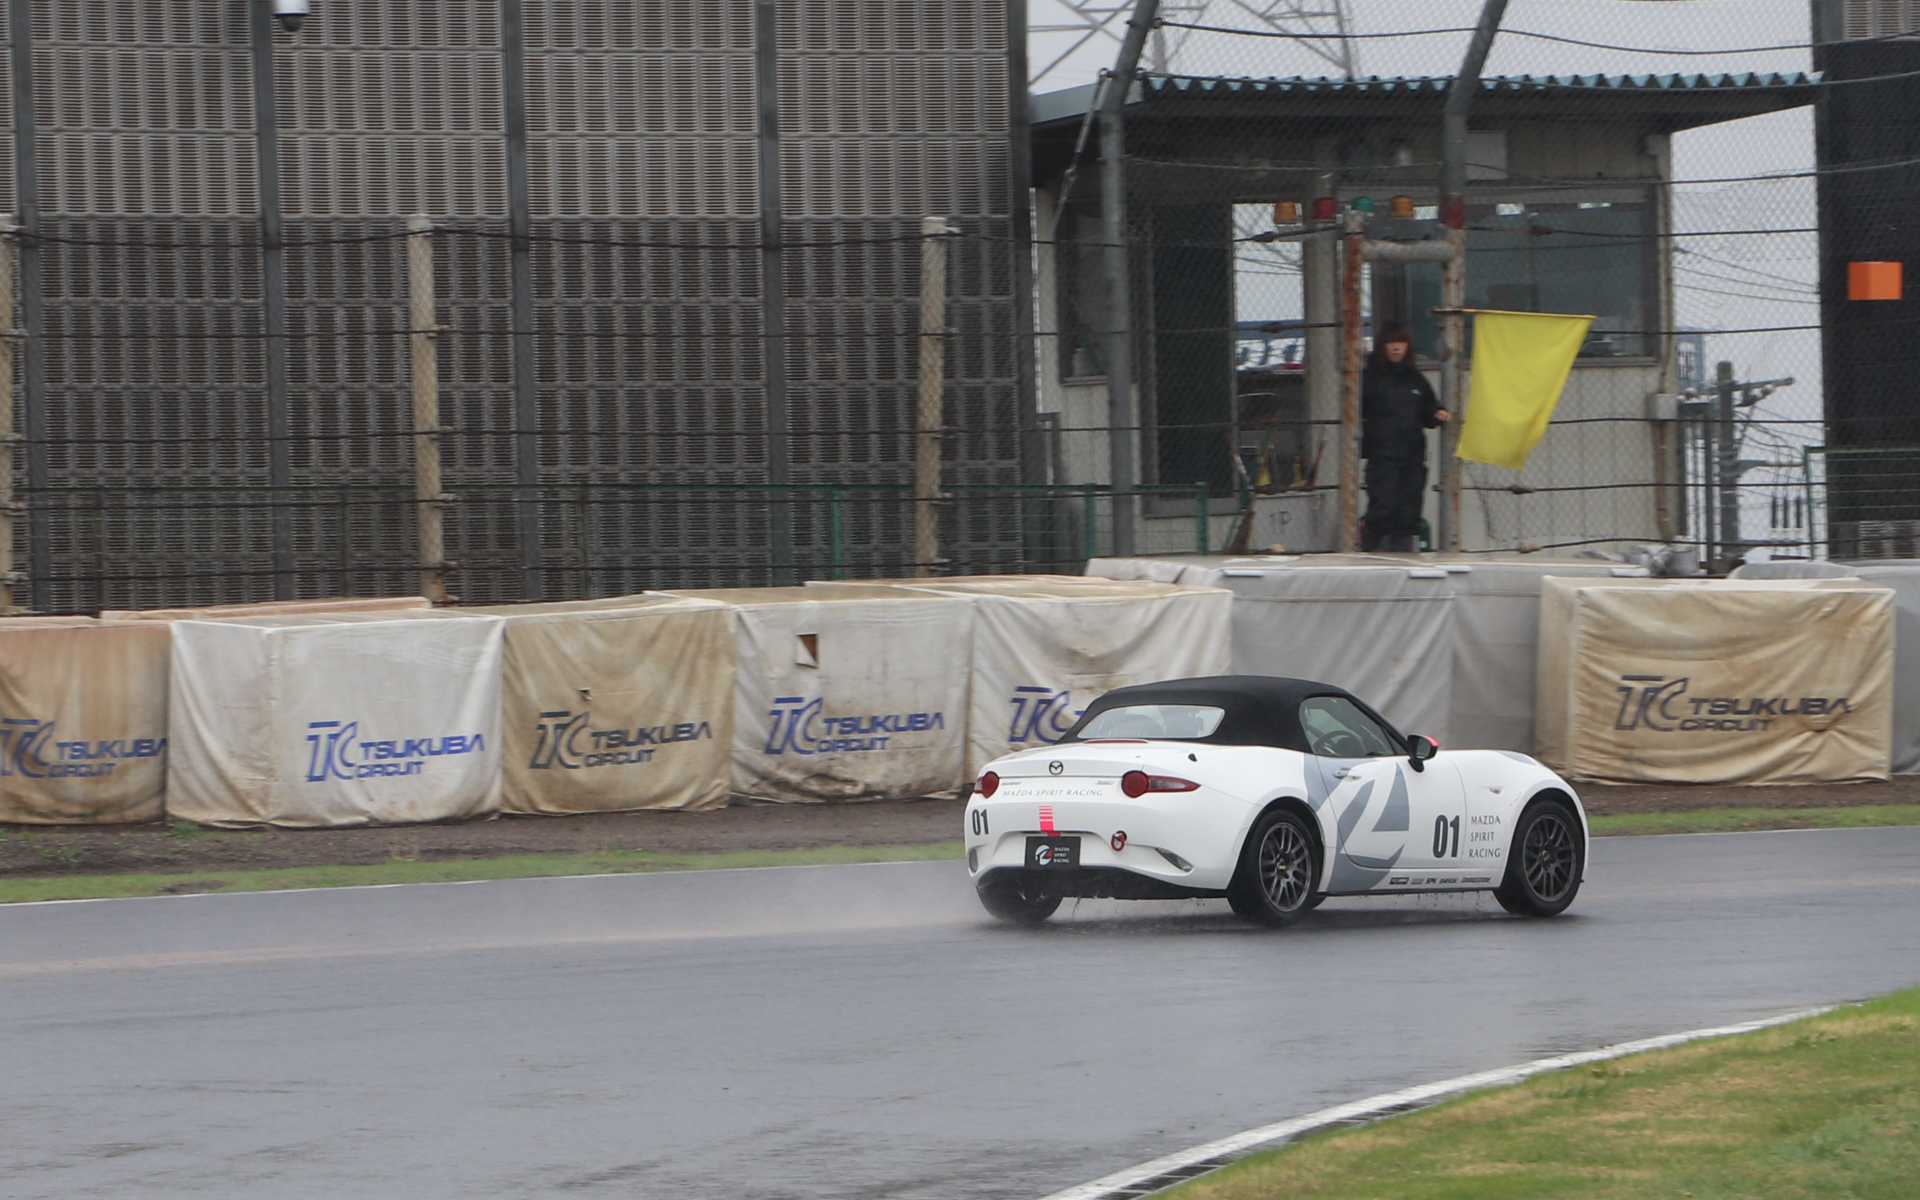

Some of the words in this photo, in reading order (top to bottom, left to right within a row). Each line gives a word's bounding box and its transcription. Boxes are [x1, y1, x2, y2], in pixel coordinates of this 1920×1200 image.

[1690, 698, 1853, 716] TSUKUBA
[823, 712, 945, 736] TSUKUBA
[1679, 718, 1773, 732] CIRCUIT
[591, 721, 713, 750] TSUKUBA
[360, 733, 486, 761] TSUKUBA
[818, 737, 890, 753] CIRCUIT
[584, 749, 656, 768] CIRCUIT
[47, 762, 117, 778] CIRCUIT
[356, 761, 425, 778] CIRCUIT
[1035, 788, 1064, 797] SPIRIT
[1065, 788, 1104, 797] RACING
[972, 808, 990, 836] 01
[1471, 816, 1501, 825] MAZDA
[1433, 815, 1460, 858] 01
[1470, 832, 1495, 841] SPIRIT
[1468, 848, 1501, 858] RACING
